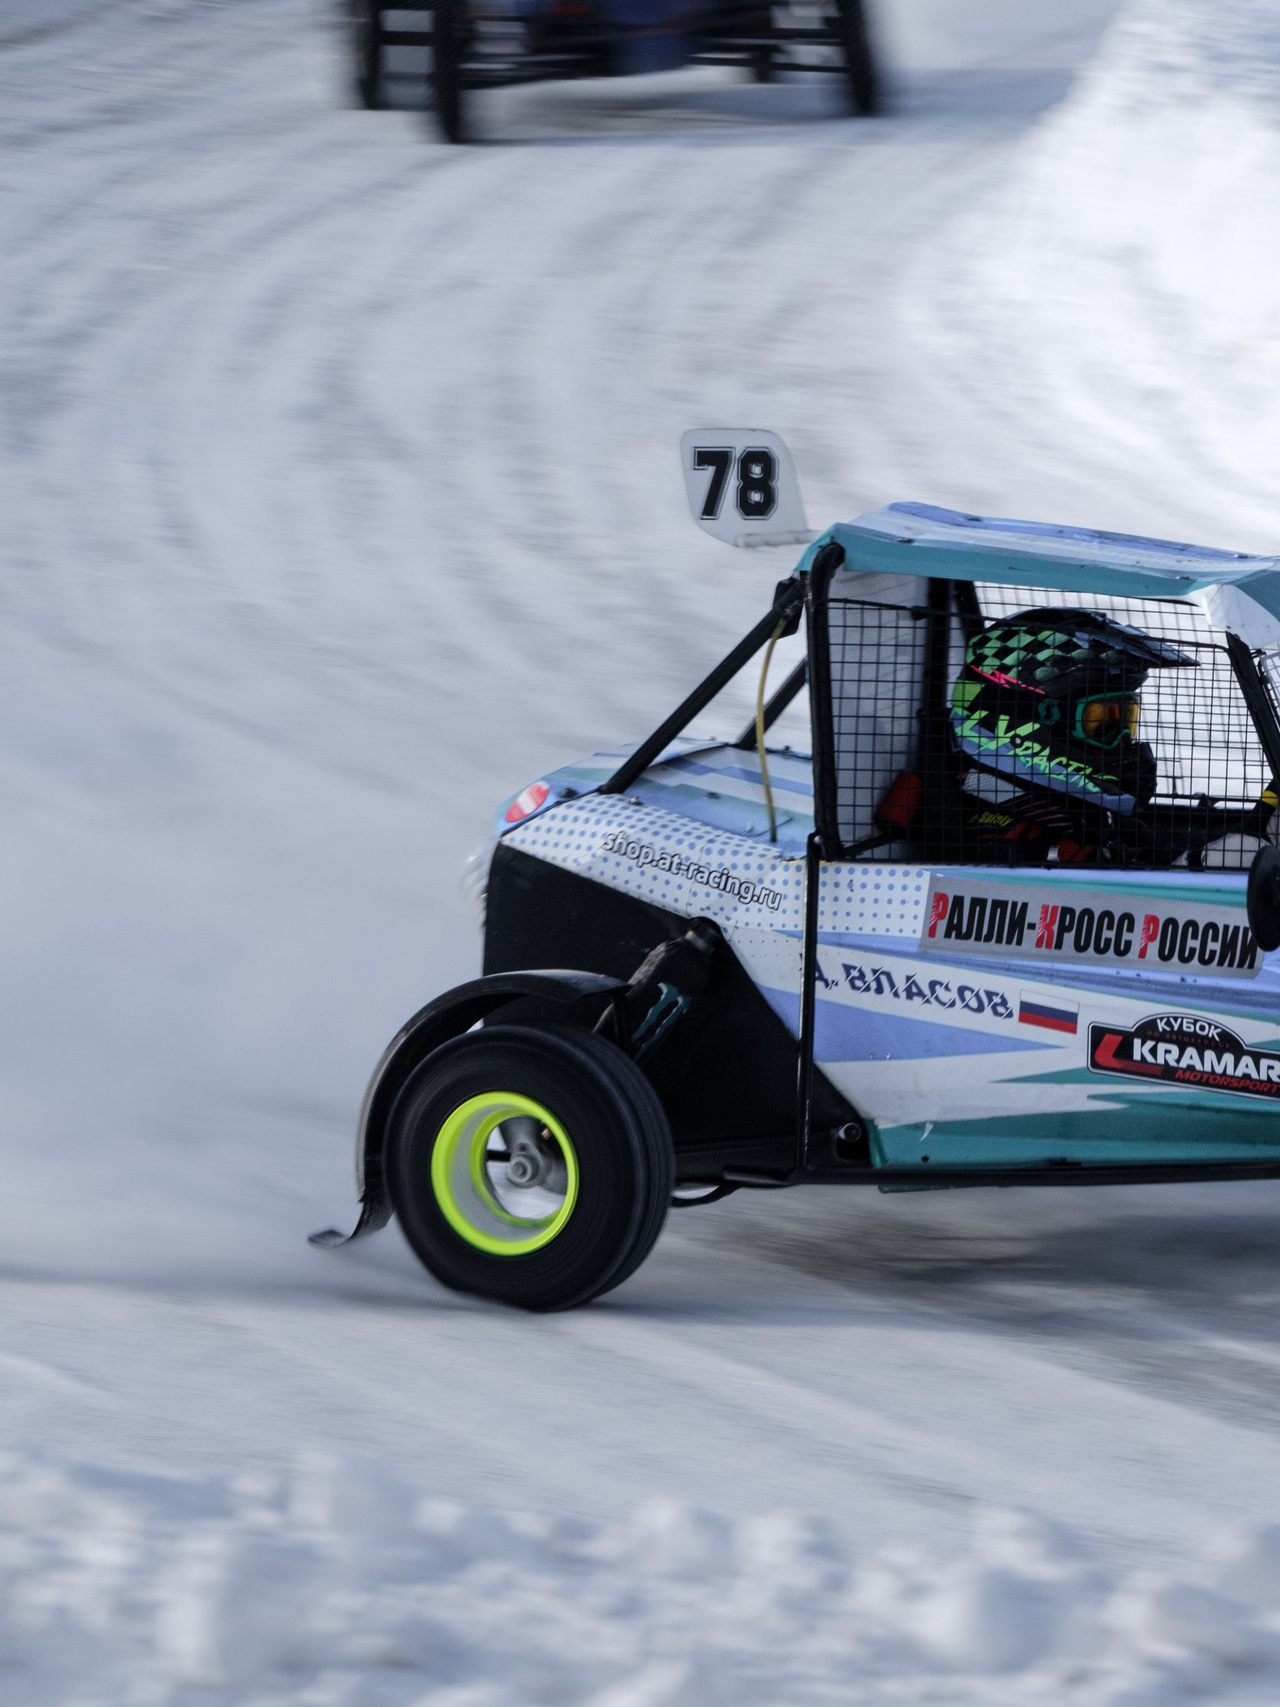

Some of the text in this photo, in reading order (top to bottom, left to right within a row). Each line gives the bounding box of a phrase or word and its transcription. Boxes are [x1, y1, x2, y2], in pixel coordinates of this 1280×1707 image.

[693, 446, 779, 520] 78
[602, 831, 782, 911] shop.at-racing.ru
[928, 892, 1258, 969] РАЛЛИ-КРОСС РОССИИ
[1157, 1017, 1222, 1041] КУБОК
[1174, 1069, 1280, 1094] MOTORSPORT
